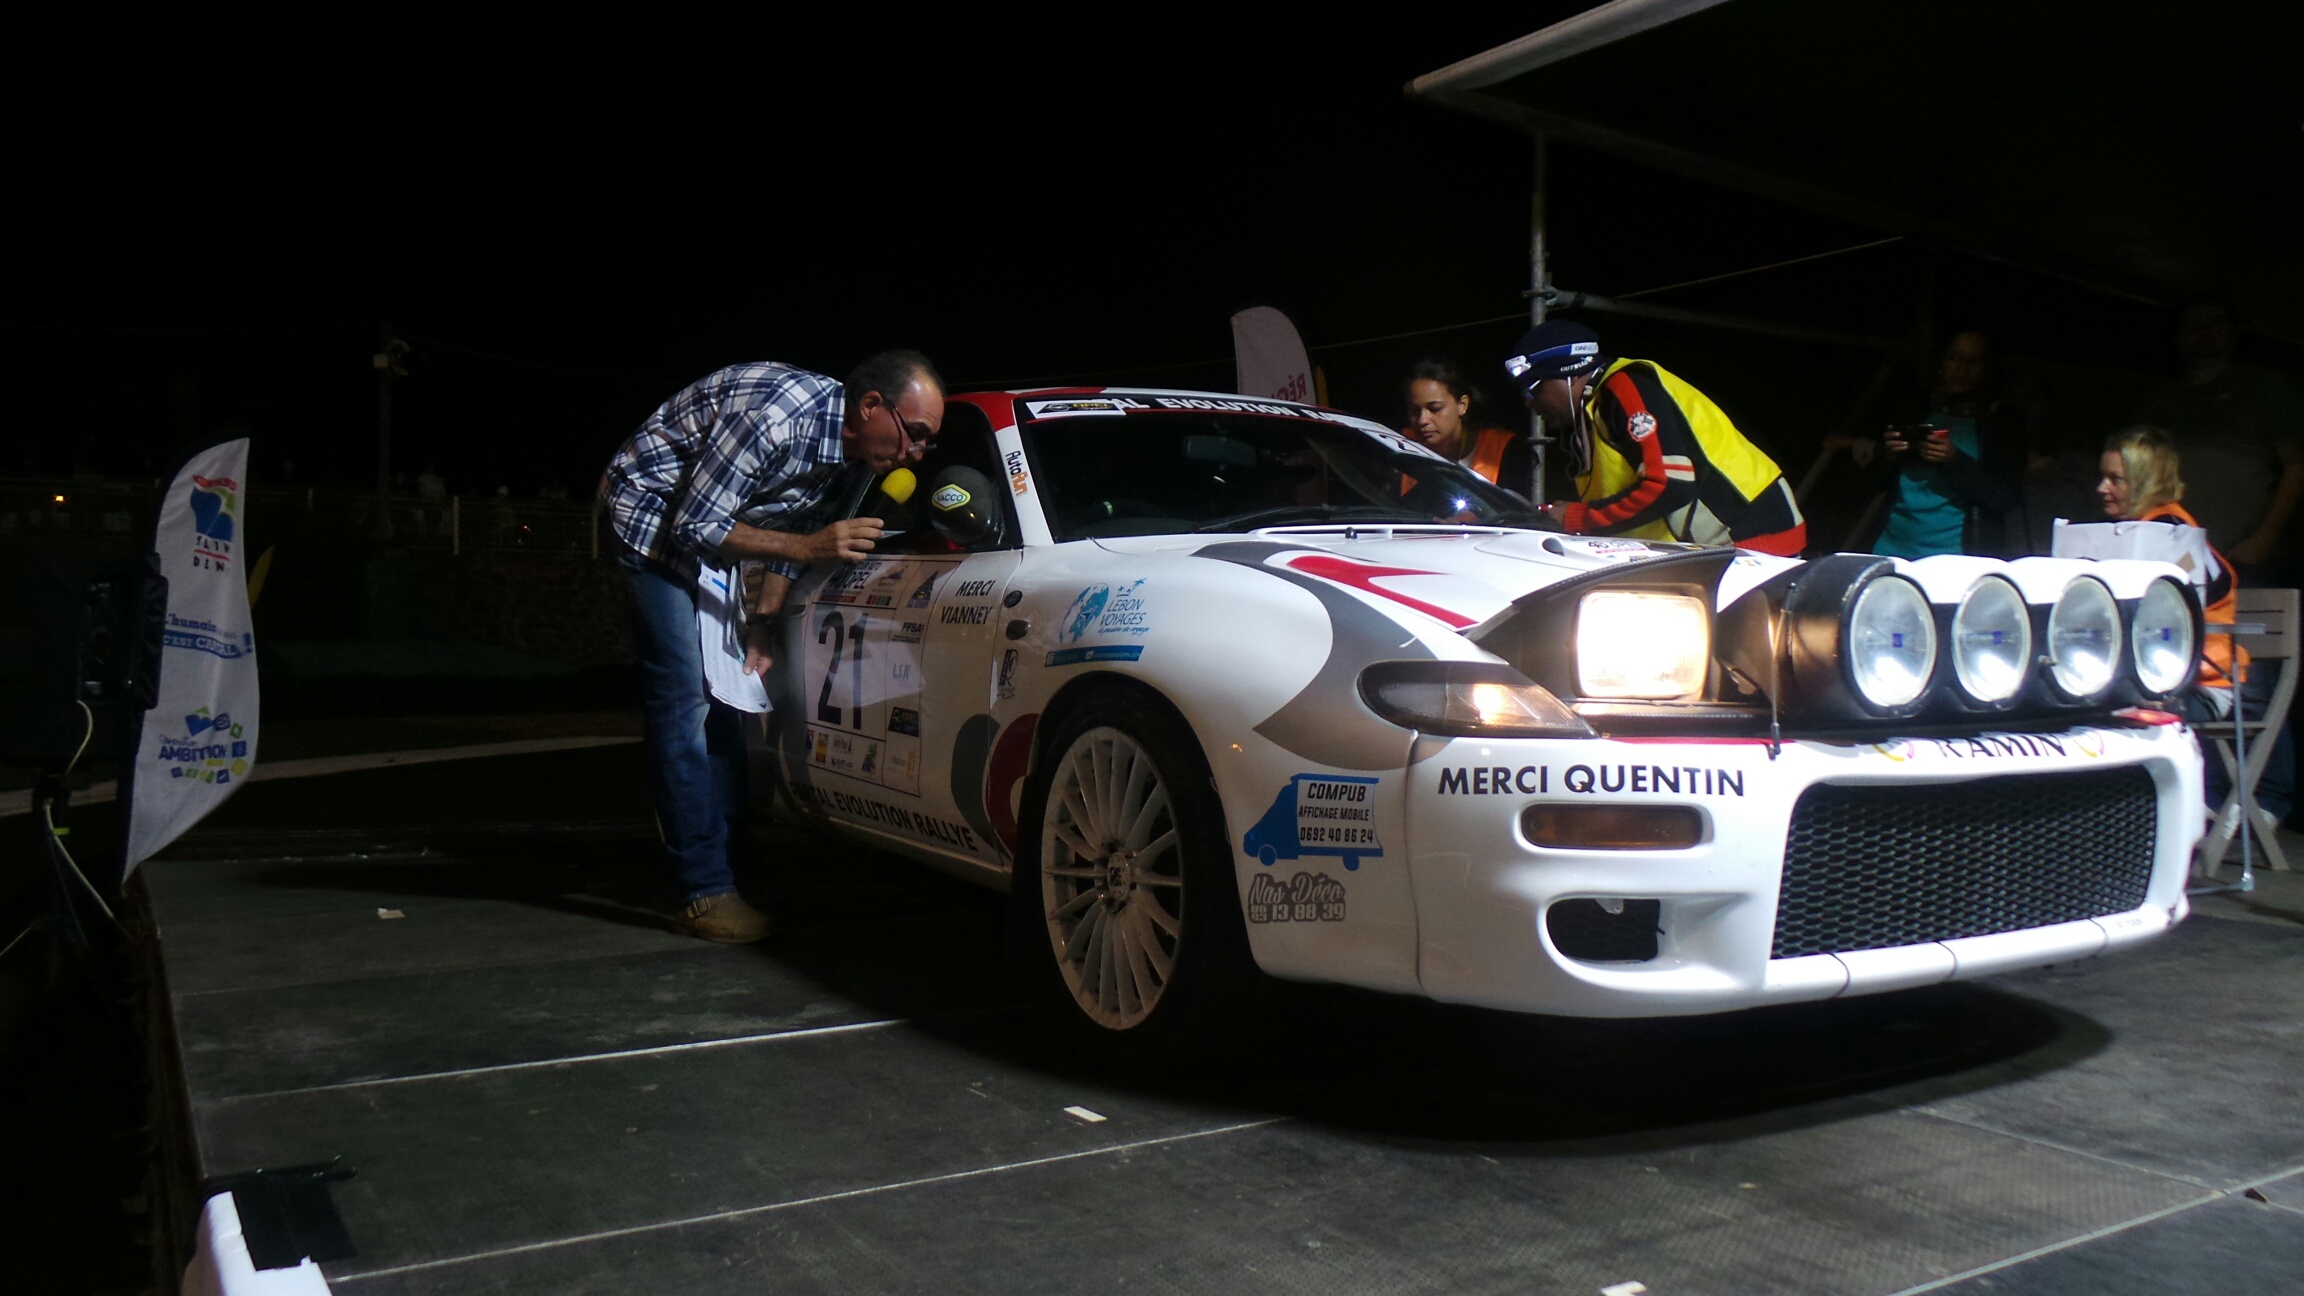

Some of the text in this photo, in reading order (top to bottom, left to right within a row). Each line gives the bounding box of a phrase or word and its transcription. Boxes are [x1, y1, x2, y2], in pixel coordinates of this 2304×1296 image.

[1154, 398, 1300, 417] EVOLUTION
[936, 493, 964, 502] YACCO
[955, 580, 996, 597] MERCI
[1106, 598, 1145, 612] LEBON
[941, 606, 993, 625] VIANNEY
[1101, 612, 1147, 626] VOYAGES
[817, 611, 869, 731] 21
[158, 744, 227, 762] AMBITION
[1438, 763, 1745, 797] MERCI QUENTIN
[1307, 782, 1367, 802] COMPUB
[836, 790, 914, 832] EVOLUTION
[914, 813, 978, 852] RALLYE
[1298, 805, 1370, 821] AFFICHAGE MOBILE
[1300, 826, 1326, 842] 0692
[1328, 827, 1341, 842] 40
[1360, 828, 1374, 844] 24
[1250, 873, 1344, 906] Nas Déco
[1272, 903, 1289, 920] 13
[1294, 903, 1317, 920] 88
[1323, 902, 1345, 920] 39
